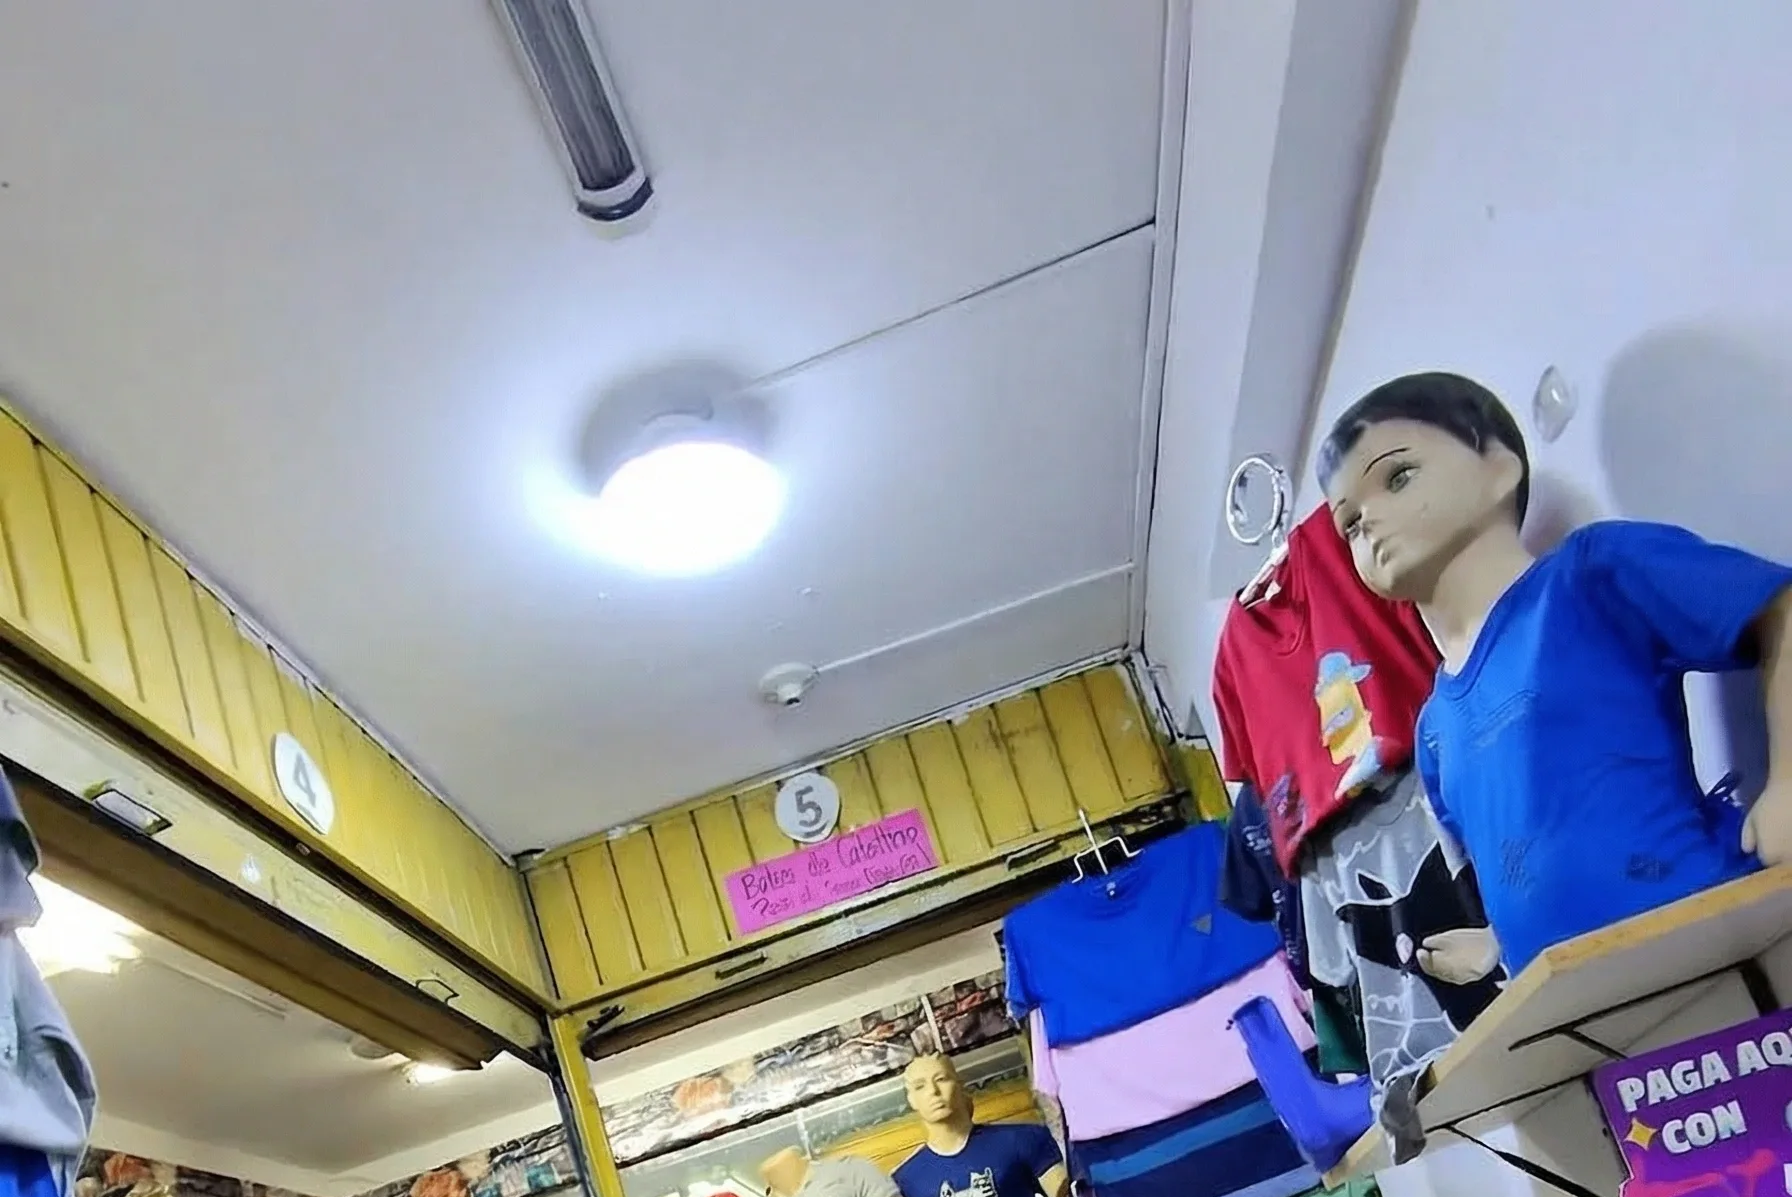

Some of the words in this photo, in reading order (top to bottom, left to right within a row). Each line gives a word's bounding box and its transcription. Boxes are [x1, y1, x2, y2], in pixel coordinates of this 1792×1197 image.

[293, 752, 317, 808] 4
[794, 785, 823, 828] 5
[1616, 1050, 1733, 1113] PAGA
[1736, 1027, 1792, 1077] AQ
[1661, 1099, 1748, 1154] CON
